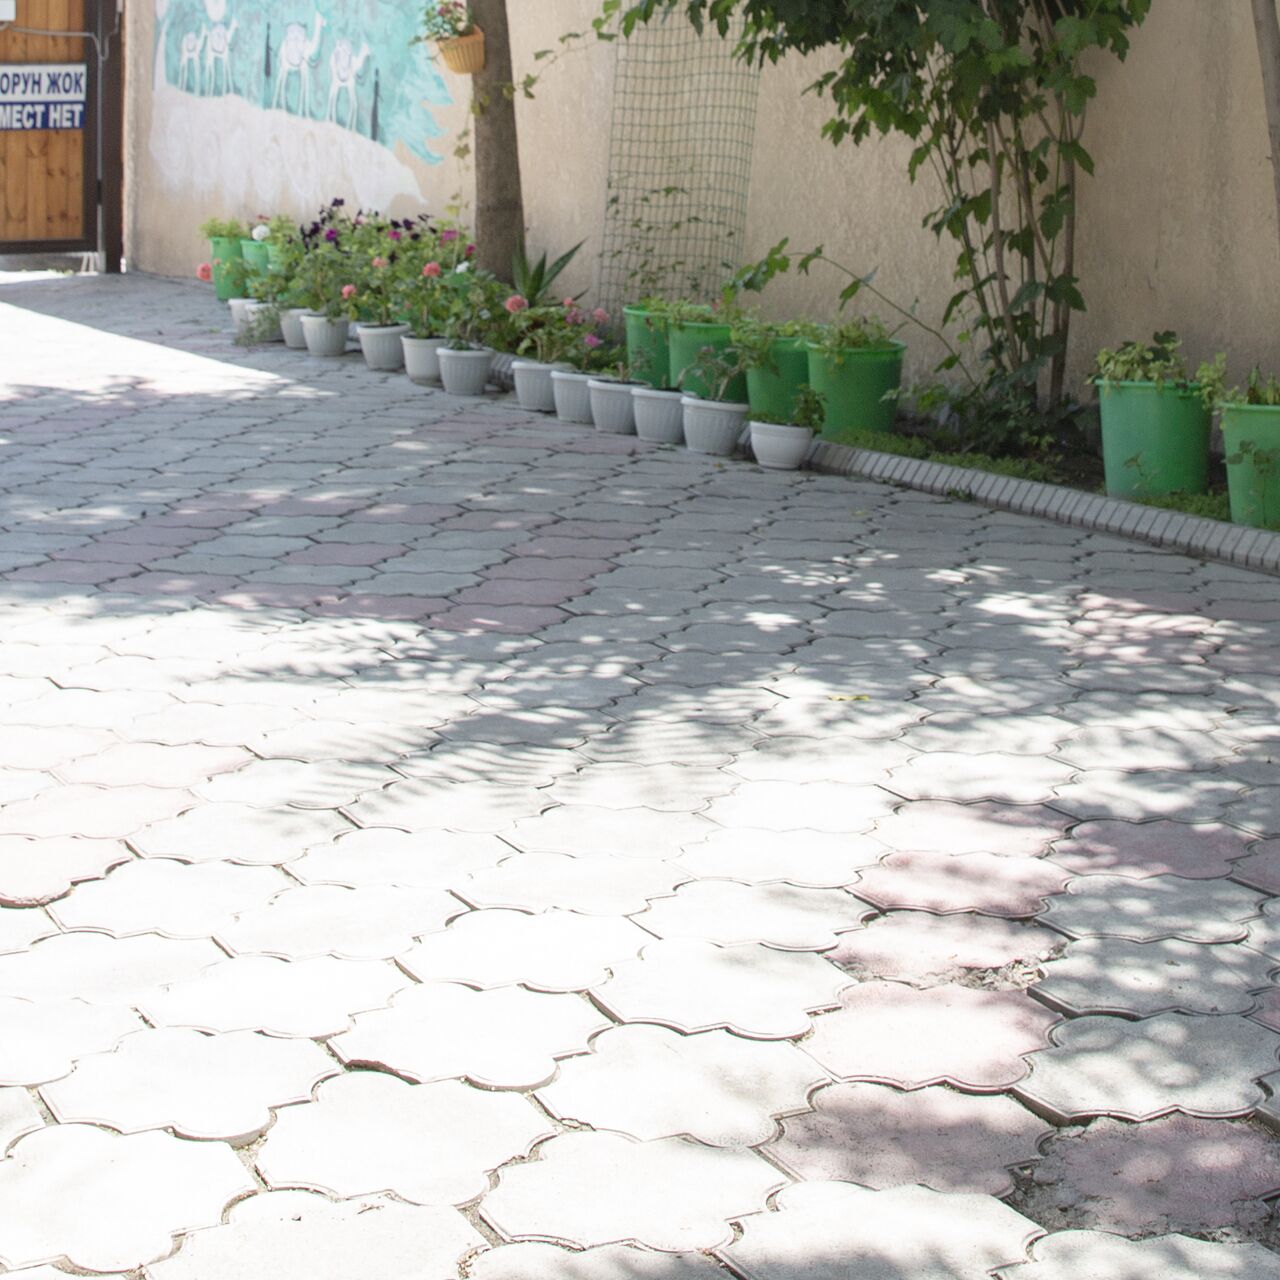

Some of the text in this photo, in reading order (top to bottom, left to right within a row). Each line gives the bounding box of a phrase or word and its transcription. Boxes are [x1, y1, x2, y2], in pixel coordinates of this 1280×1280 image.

[0, 72, 83, 95] ОРУН ЖОК
[48, 104, 83, 128] НЕТ
